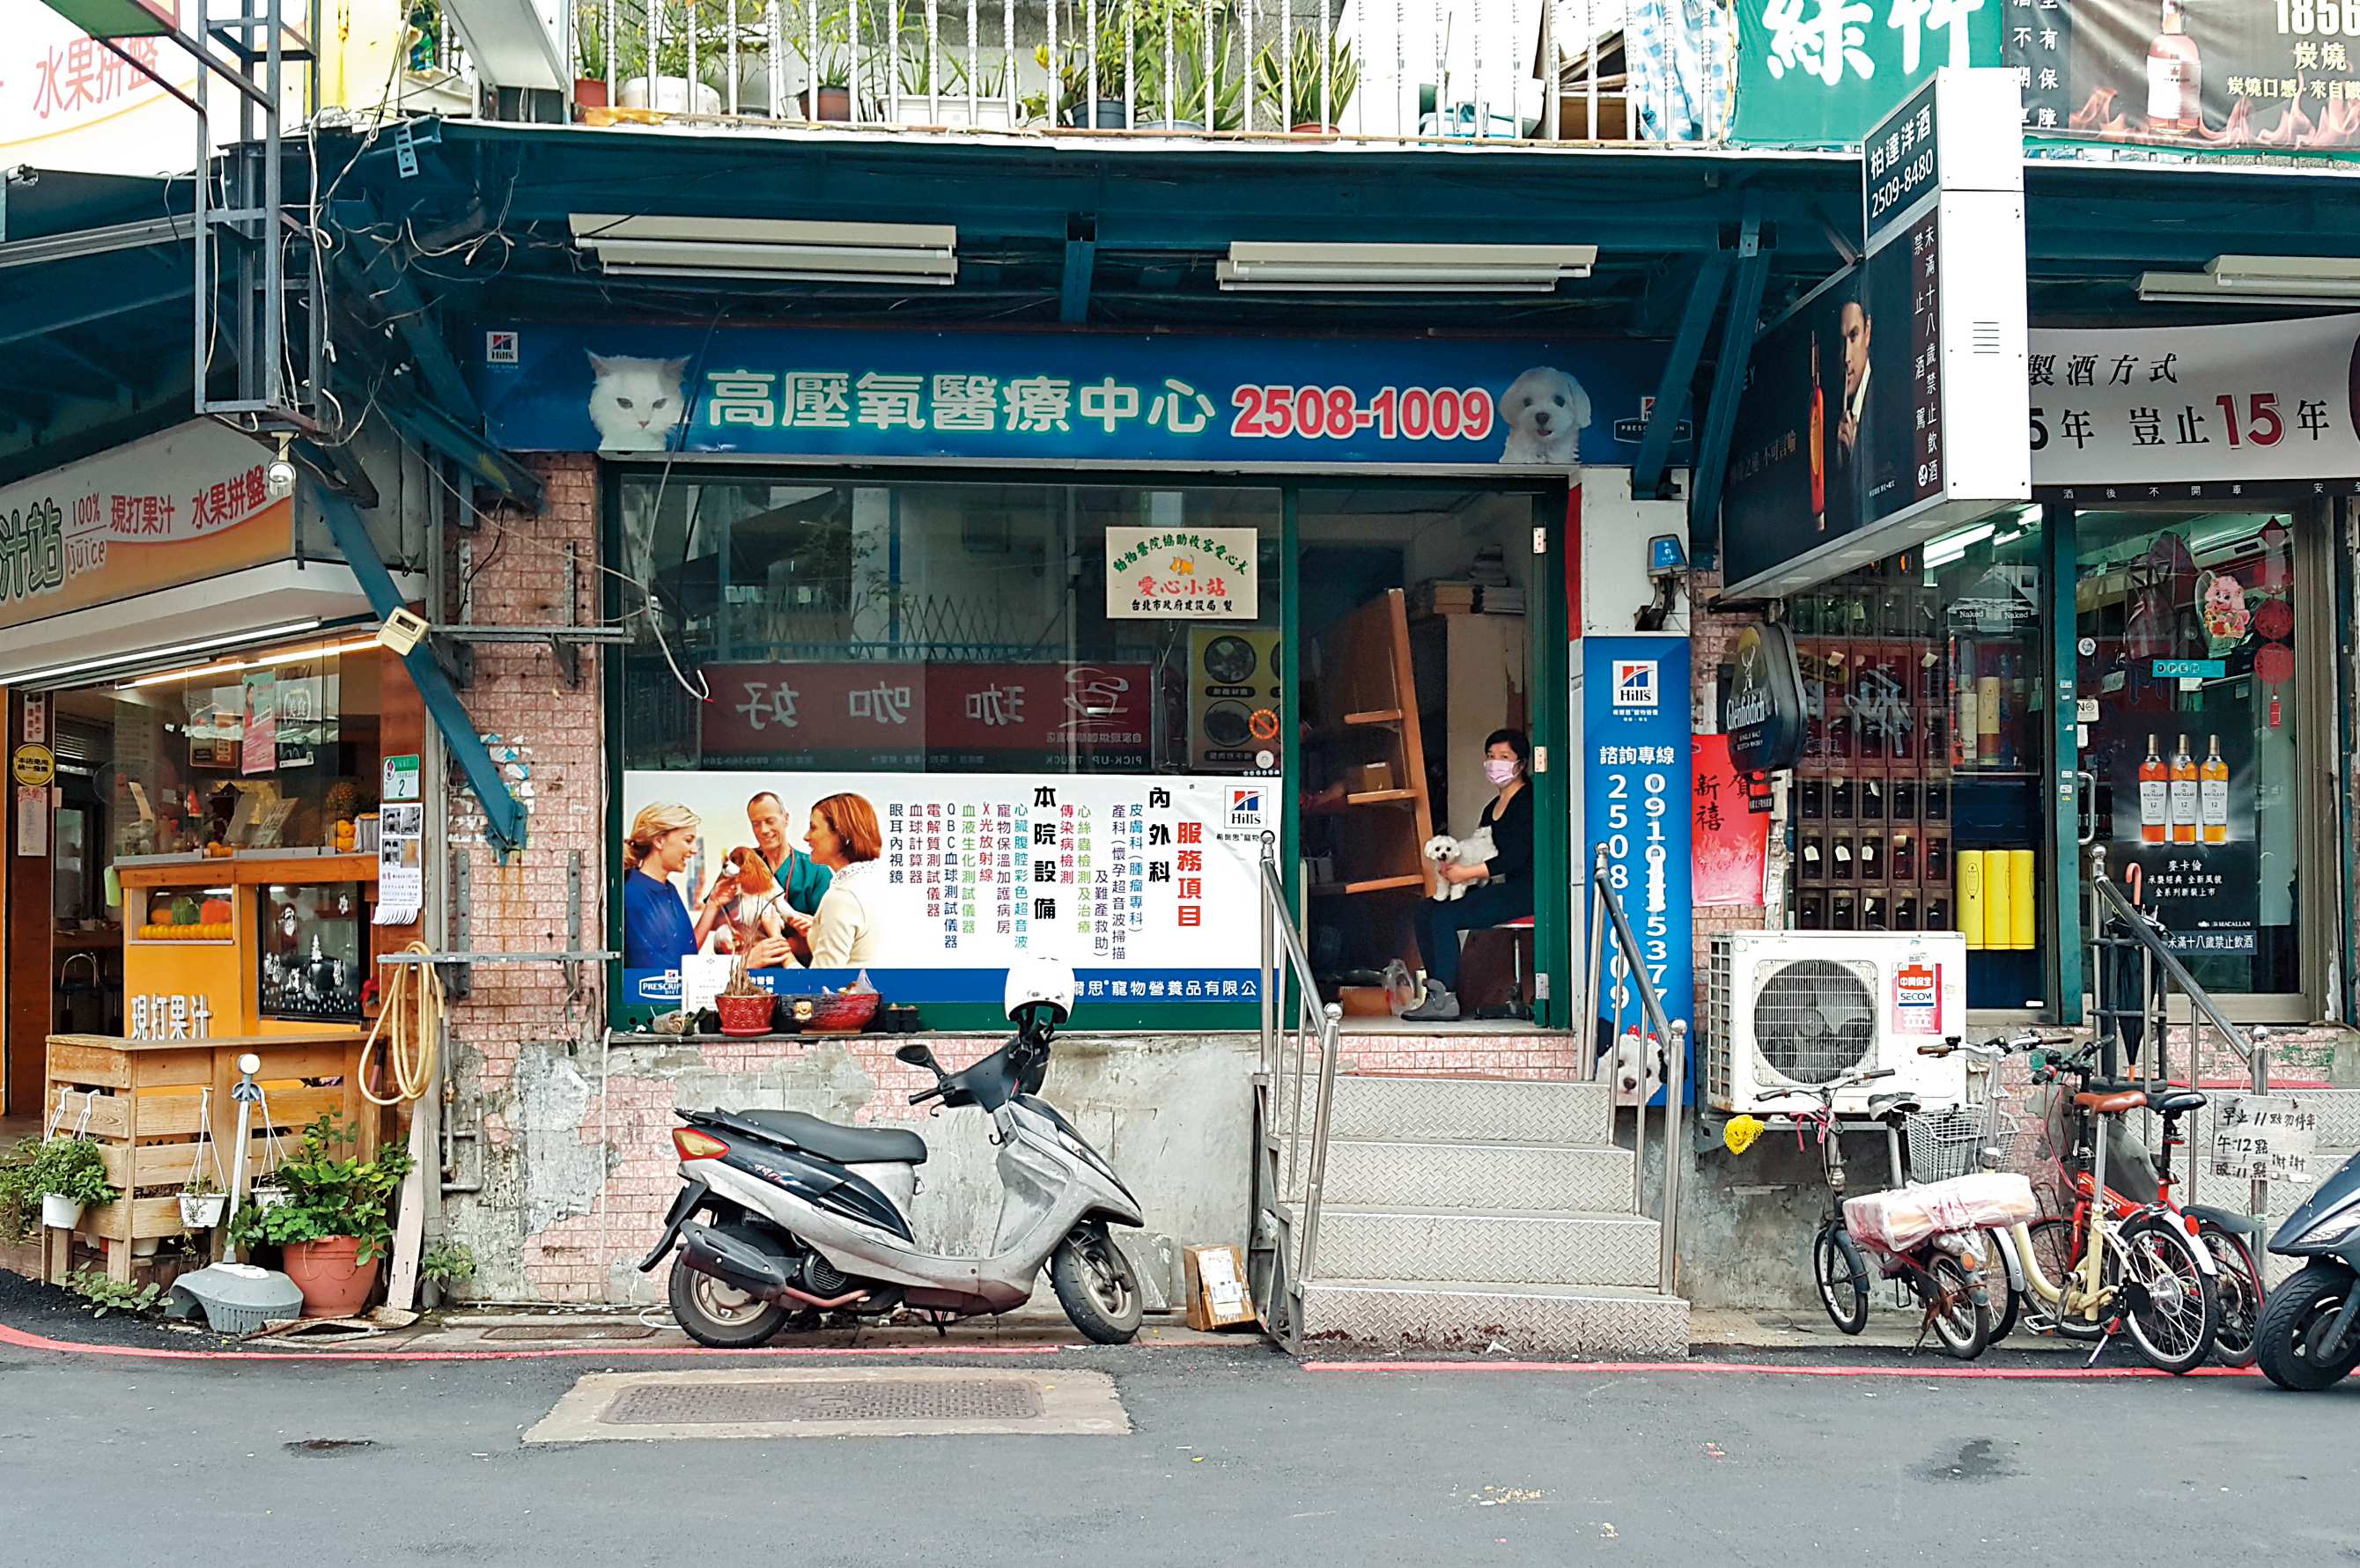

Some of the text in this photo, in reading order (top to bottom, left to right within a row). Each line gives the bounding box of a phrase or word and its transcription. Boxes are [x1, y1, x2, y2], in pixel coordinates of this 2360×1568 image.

[2293, 40, 2347, 71] 炭燒
[1870, 103, 1931, 180] 柏達洋酒
[1871, 148, 1934, 219] 2509-8480
[1924, 225, 1938, 483] 未滿十八歲禁止飲酒
[2029, 352, 2179, 386] 製酒方式
[706, 369, 1494, 441] 高壓氧醫療中心 2508-1009
[71, 491, 101, 527] 100%
[111, 494, 175, 535] 現打果汁
[191, 464, 268, 530] 水果拼盤
[2063, 483, 2243, 499] 酒後不開車
[69, 539, 106, 575] juice
[1137, 575, 1227, 599] 愛心小站
[1131, 599, 1216, 613] 台北市政府建設局
[1620, 689, 1652, 702] Hill's
[1726, 691, 1765, 730] Glenfiddich
[398, 778, 405, 797] 2
[1599, 746, 1675, 765] 諮詢專線
[1148, 786, 1171, 883] 內外科
[1231, 813, 1261, 825] Hill's
[1694, 774, 1725, 832] 新禧
[889, 803, 903, 884] 眼耳內視鏡
[909, 804, 923, 884] 血球計算器
[926, 804, 940, 917] 電解質測試儀器
[962, 804, 976, 934] 血液生化測試儀器
[979, 802, 993, 882] X光放射線
[996, 804, 1011, 934] 寵物保溫加護病房
[1034, 785, 1057, 920] 本院設備
[1059, 804, 1074, 884] 傳染病檢測
[1077, 805, 1091, 934] 心絲蟲檢測及治療
[1128, 803, 1144, 932] 皮膚科(腫瘤專科)
[1176, 821, 1203, 927] 服務項目
[2168, 859, 2202, 872] 麥卡倫
[944, 803, 958, 949] QBC血球測試儀器
[1014, 803, 1029, 948] 心臟腹腔彩色超音波
[2155, 887, 2216, 897] 全系列新裝上市
[1094, 870, 1109, 957] 及難產救助)
[2167, 935, 2253, 950] 未滿十八歲禁止飲酒
[131, 992, 212, 1041] 現打果汁
[1900, 992, 1932, 1001] SECOM
